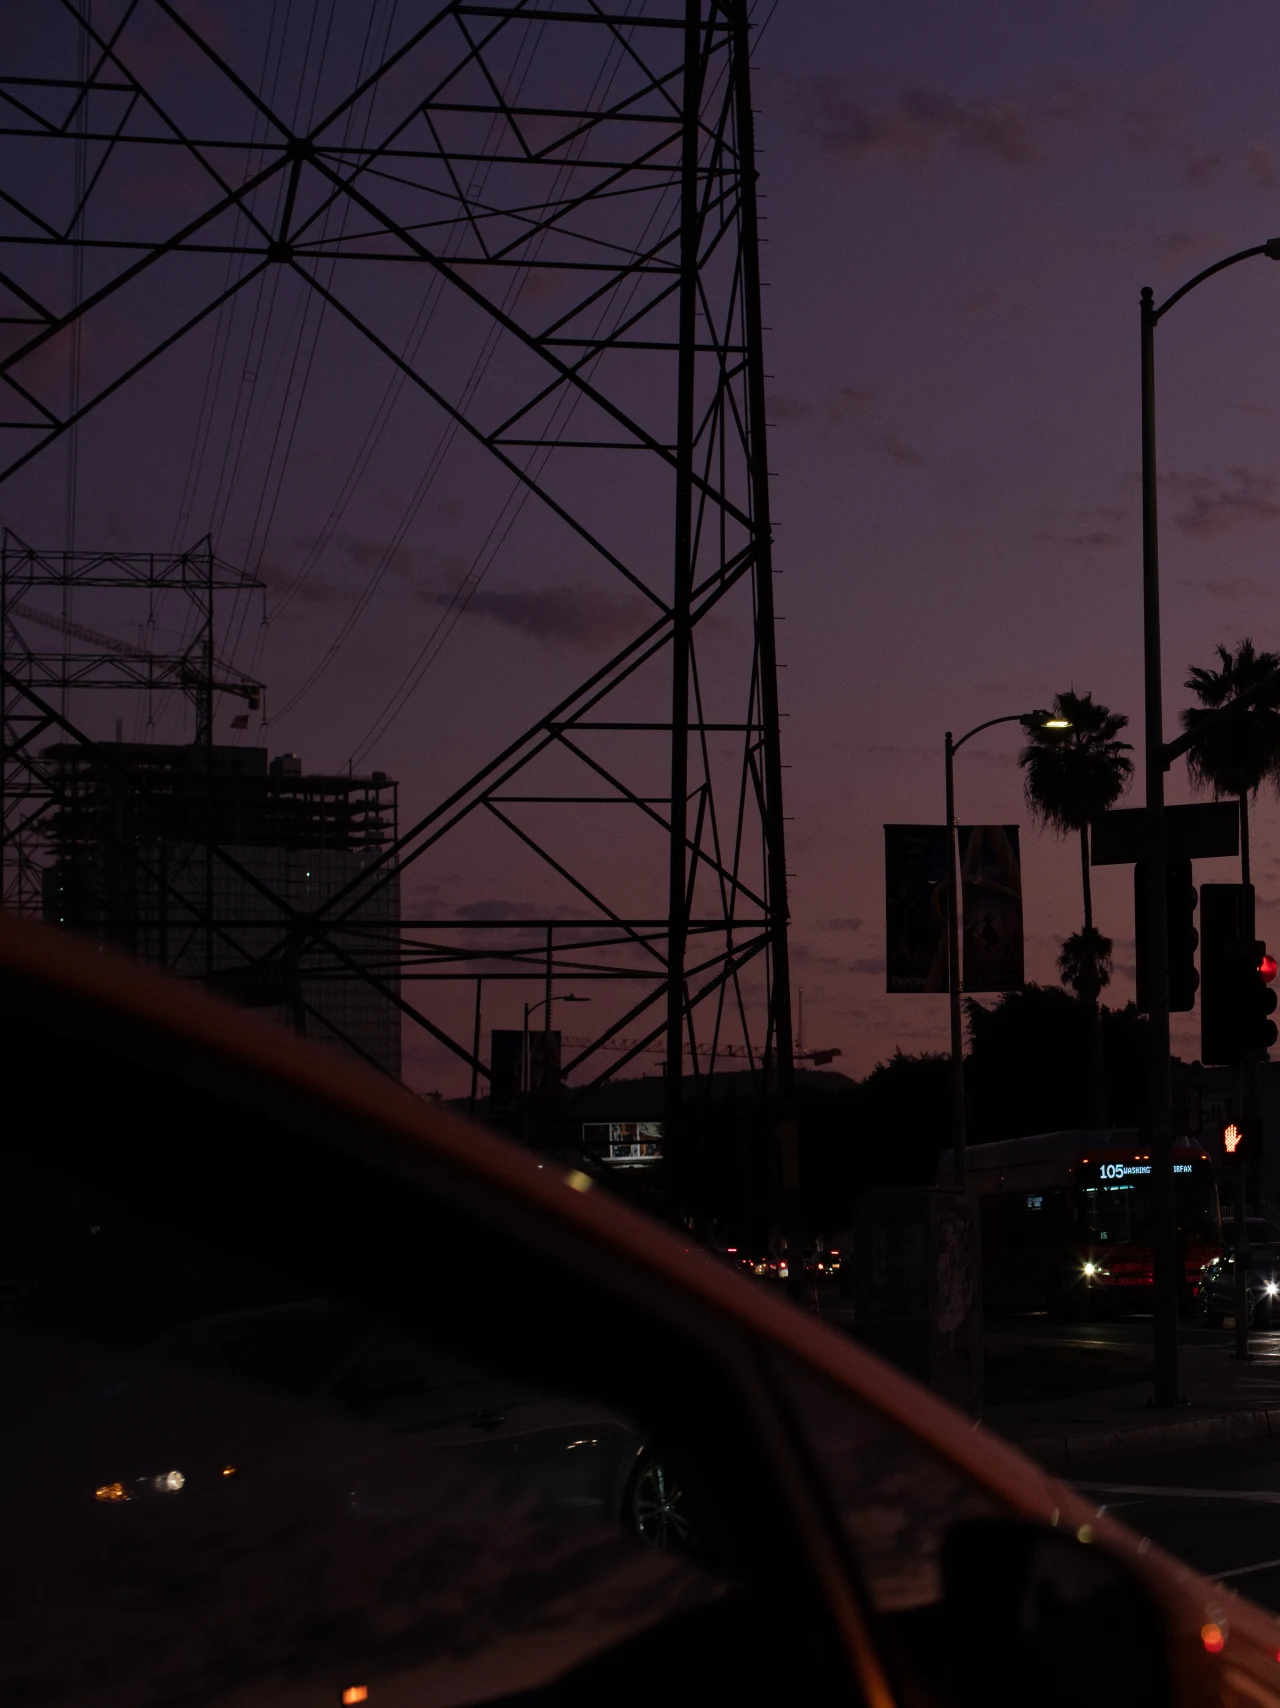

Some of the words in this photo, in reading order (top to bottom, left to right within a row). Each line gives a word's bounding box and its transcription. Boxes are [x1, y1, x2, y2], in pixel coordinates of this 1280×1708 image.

[1099, 1164, 1123, 1179] 105
[1123, 1166, 1152, 1175] WASHING
[1173, 1165, 1193, 1173] IRFAX
